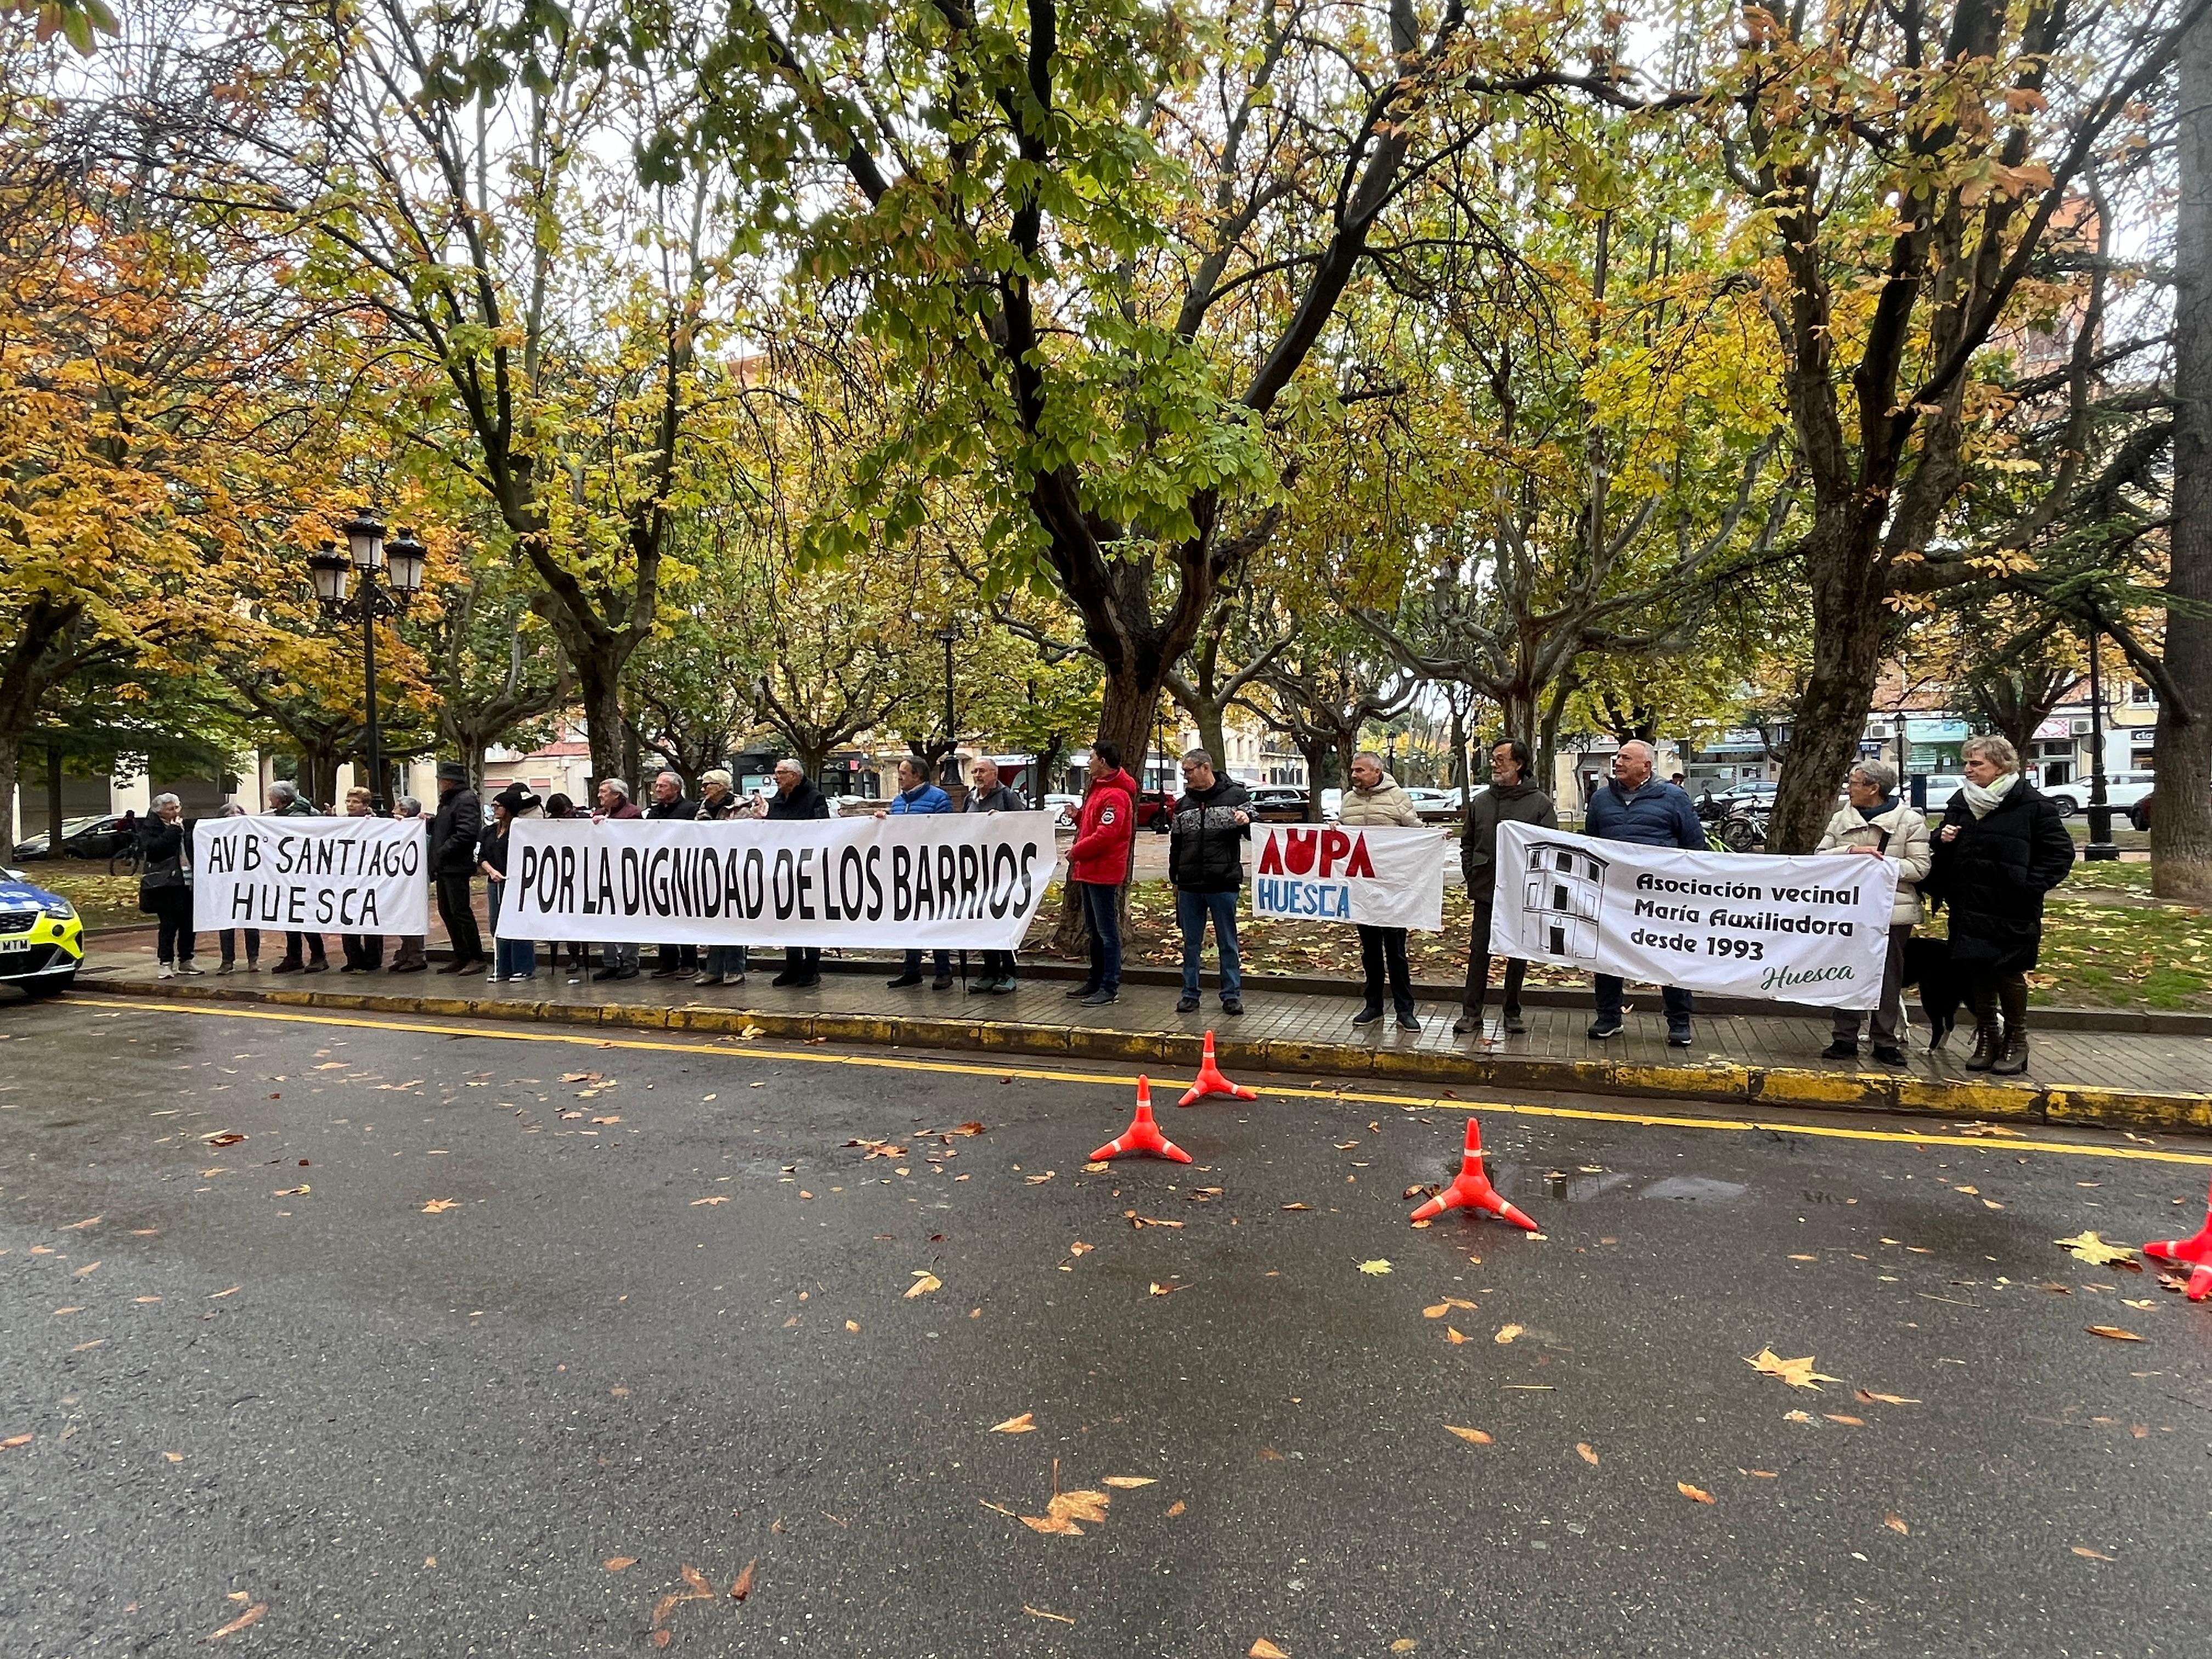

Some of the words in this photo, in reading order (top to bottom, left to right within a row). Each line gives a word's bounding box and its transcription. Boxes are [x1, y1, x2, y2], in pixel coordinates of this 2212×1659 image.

[276, 836, 418, 878] SANTIAGO
[1257, 828, 1376, 878] AUPA
[518, 845, 575, 913] POR
[582, 847, 616, 915] LA
[621, 847, 764, 919] DIGNIDAD
[772, 848, 816, 921] DE
[822, 845, 883, 922] LOS
[892, 842, 1037, 922] BARRIOS
[1258, 878, 1351, 919] HUESCA
[1635, 873, 1762, 900] Asociación
[1771, 885, 1860, 905] vecinal
[232, 882, 379, 926] HUESCA
[1634, 898, 1700, 923] María
[1709, 909, 1853, 937] Auxiliadora
[2, 939, 27, 950] MTM
[1630, 928, 1697, 953] desde
[1707, 936, 1764, 961] 1993
[1760, 965, 1855, 991] Huesca
